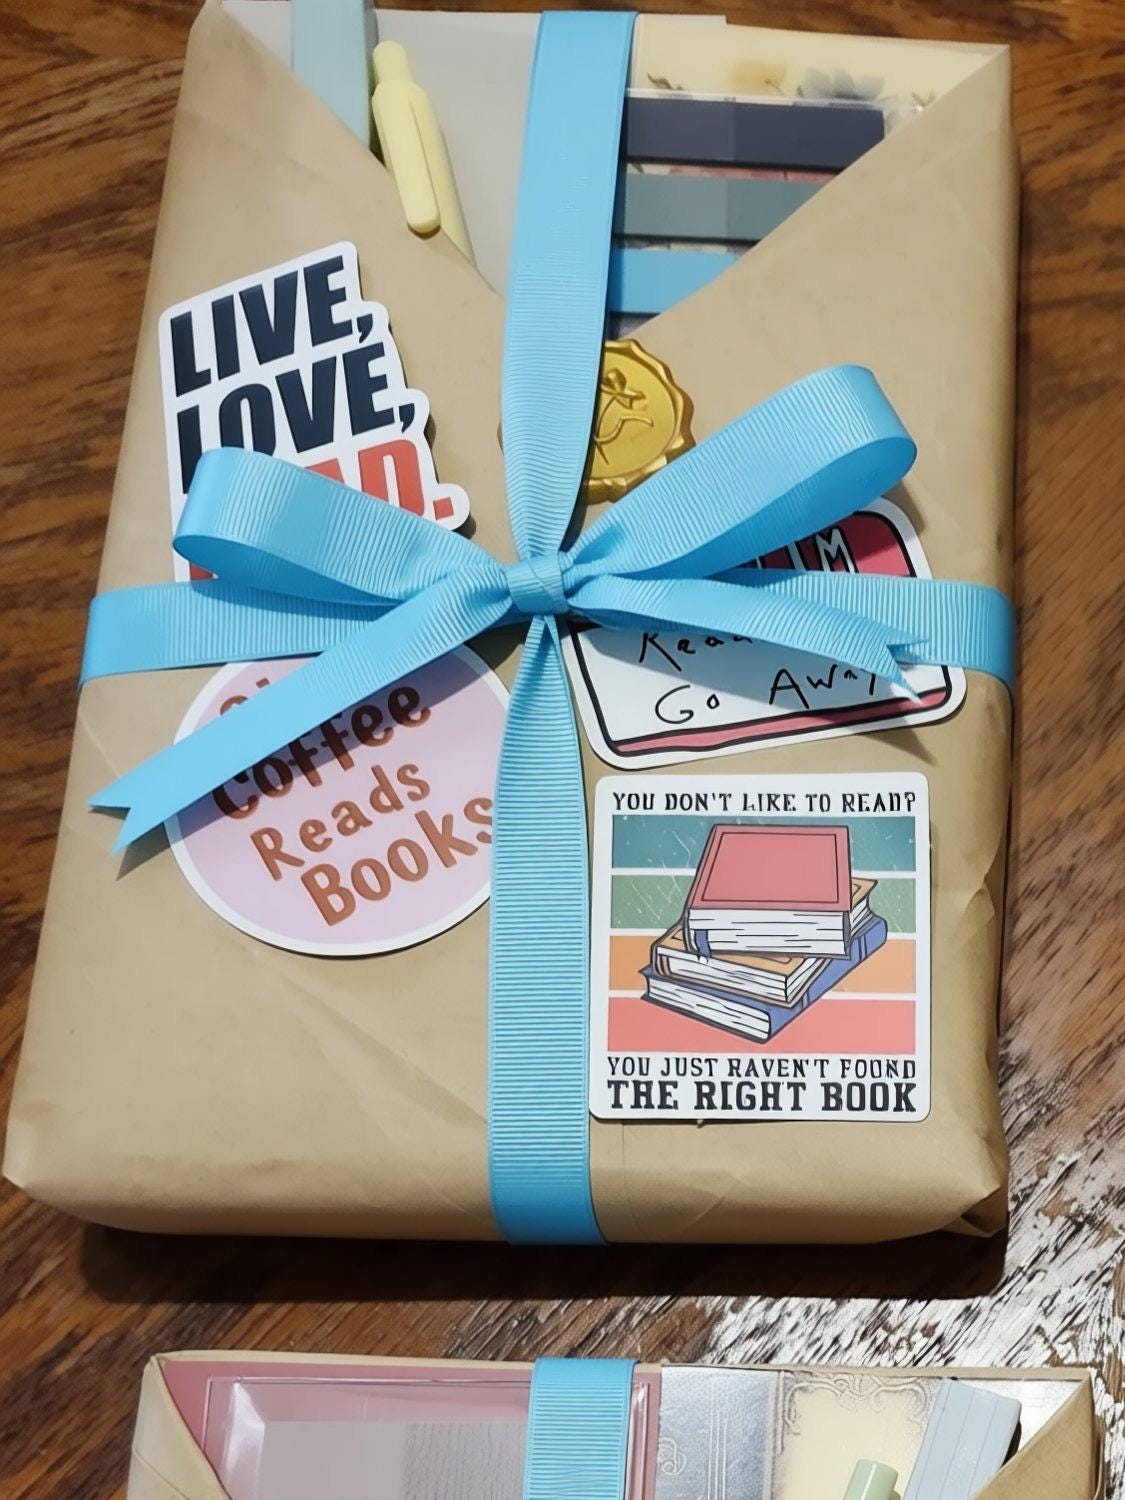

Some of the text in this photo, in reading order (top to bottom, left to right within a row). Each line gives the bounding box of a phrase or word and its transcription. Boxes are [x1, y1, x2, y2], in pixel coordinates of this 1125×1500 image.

[170, 255, 374, 398] LIVE,
[655, 684, 720, 724] Go
[212, 686, 431, 819] Coffee
[250, 764, 430, 881] Reads
[612, 792, 916, 813] YOU DON'T LIKE TO READ?
[301, 797, 493, 926] Books
[607, 1056, 650, 1077] YOU
[661, 1057, 718, 1077] JUST
[841, 1059, 916, 1080] FOUND
[607, 1080, 917, 1113] THE RIGHT BOOK
